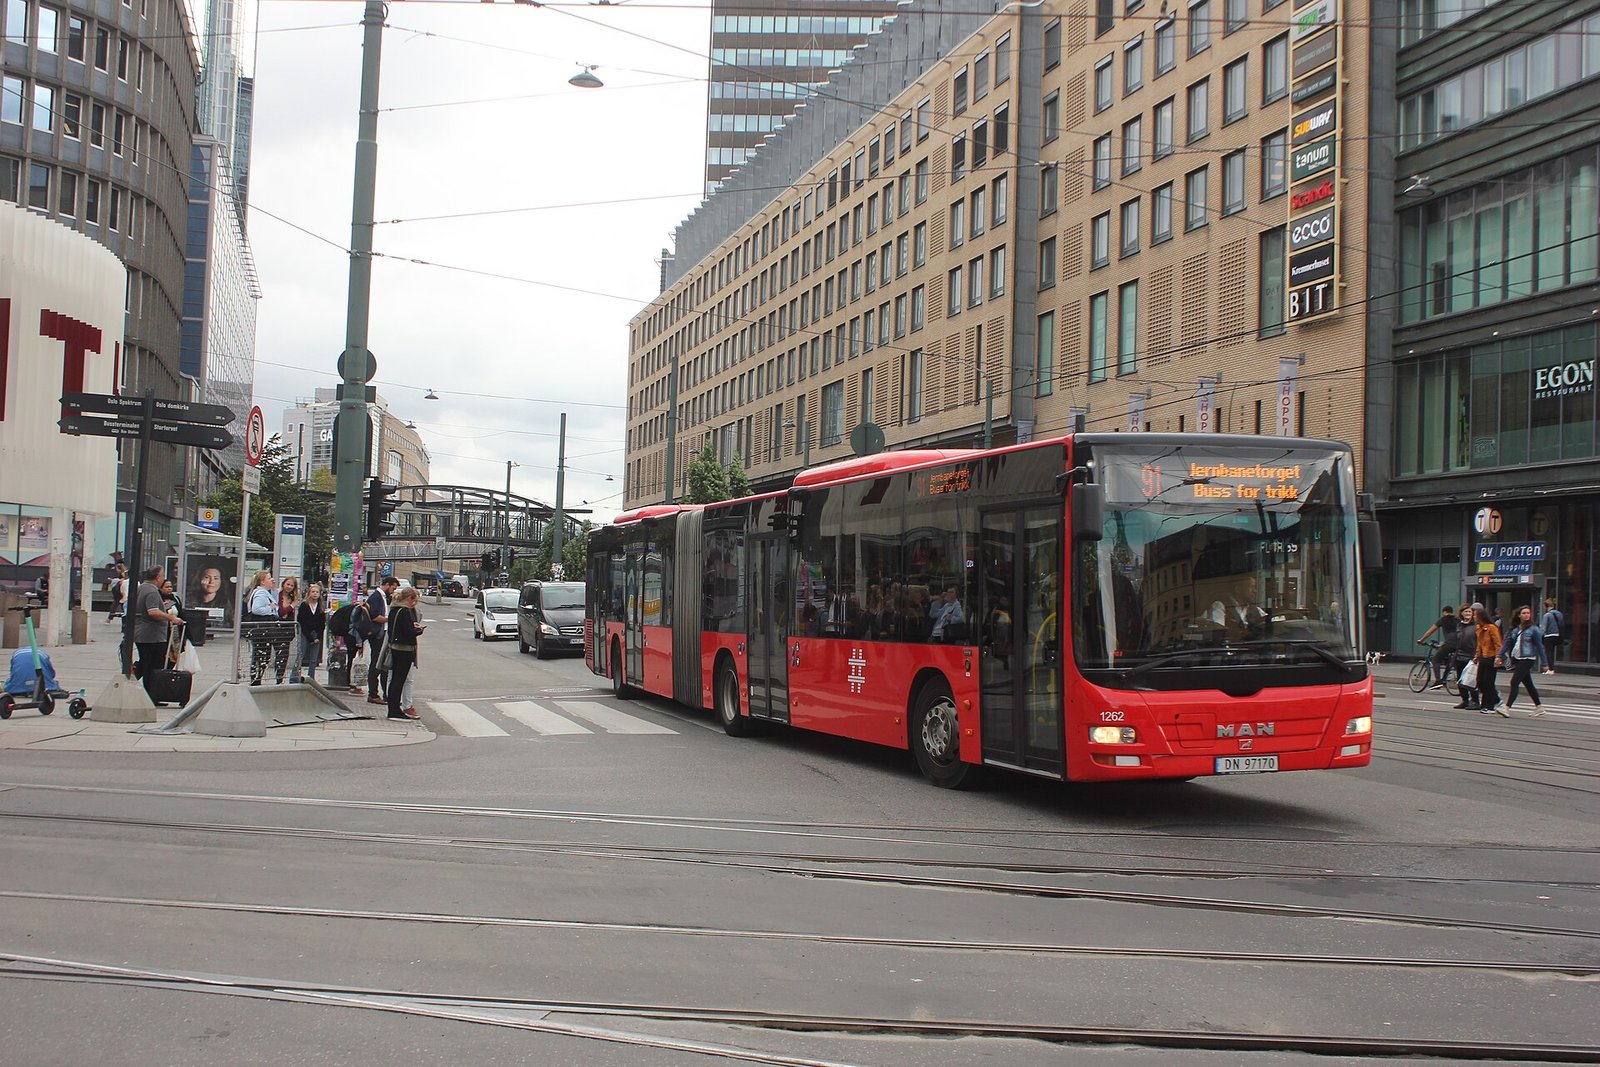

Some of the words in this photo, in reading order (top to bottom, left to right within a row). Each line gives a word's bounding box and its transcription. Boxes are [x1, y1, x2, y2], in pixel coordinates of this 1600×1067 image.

[1293, 108, 1334, 139] SUBWAY
[1296, 144, 1330, 169] tanum
[1290, 180, 1335, 211] Scandic
[1292, 216, 1331, 244] ecco
[1290, 283, 1328, 319] BIT
[1535, 359, 1595, 391] EGON
[1535, 384, 1592, 399] RESTAURANT
[119, 399, 142, 407] Spektrum
[167, 403, 190, 411] domkirke
[1141, 463, 1162, 498] 91
[1189, 462, 1301, 482] Jernbanetorget
[1193, 483, 1233, 499] Buss
[1236, 484, 1261, 499] for
[1265, 484, 1299, 500] trikk
[1497, 562, 1531, 572] shopping
[1100, 711, 1125, 722] 1262
[1216, 722, 1275, 738] MAN
[1225, 758, 1240, 770] DN
[1244, 757, 1275, 770] 97170
